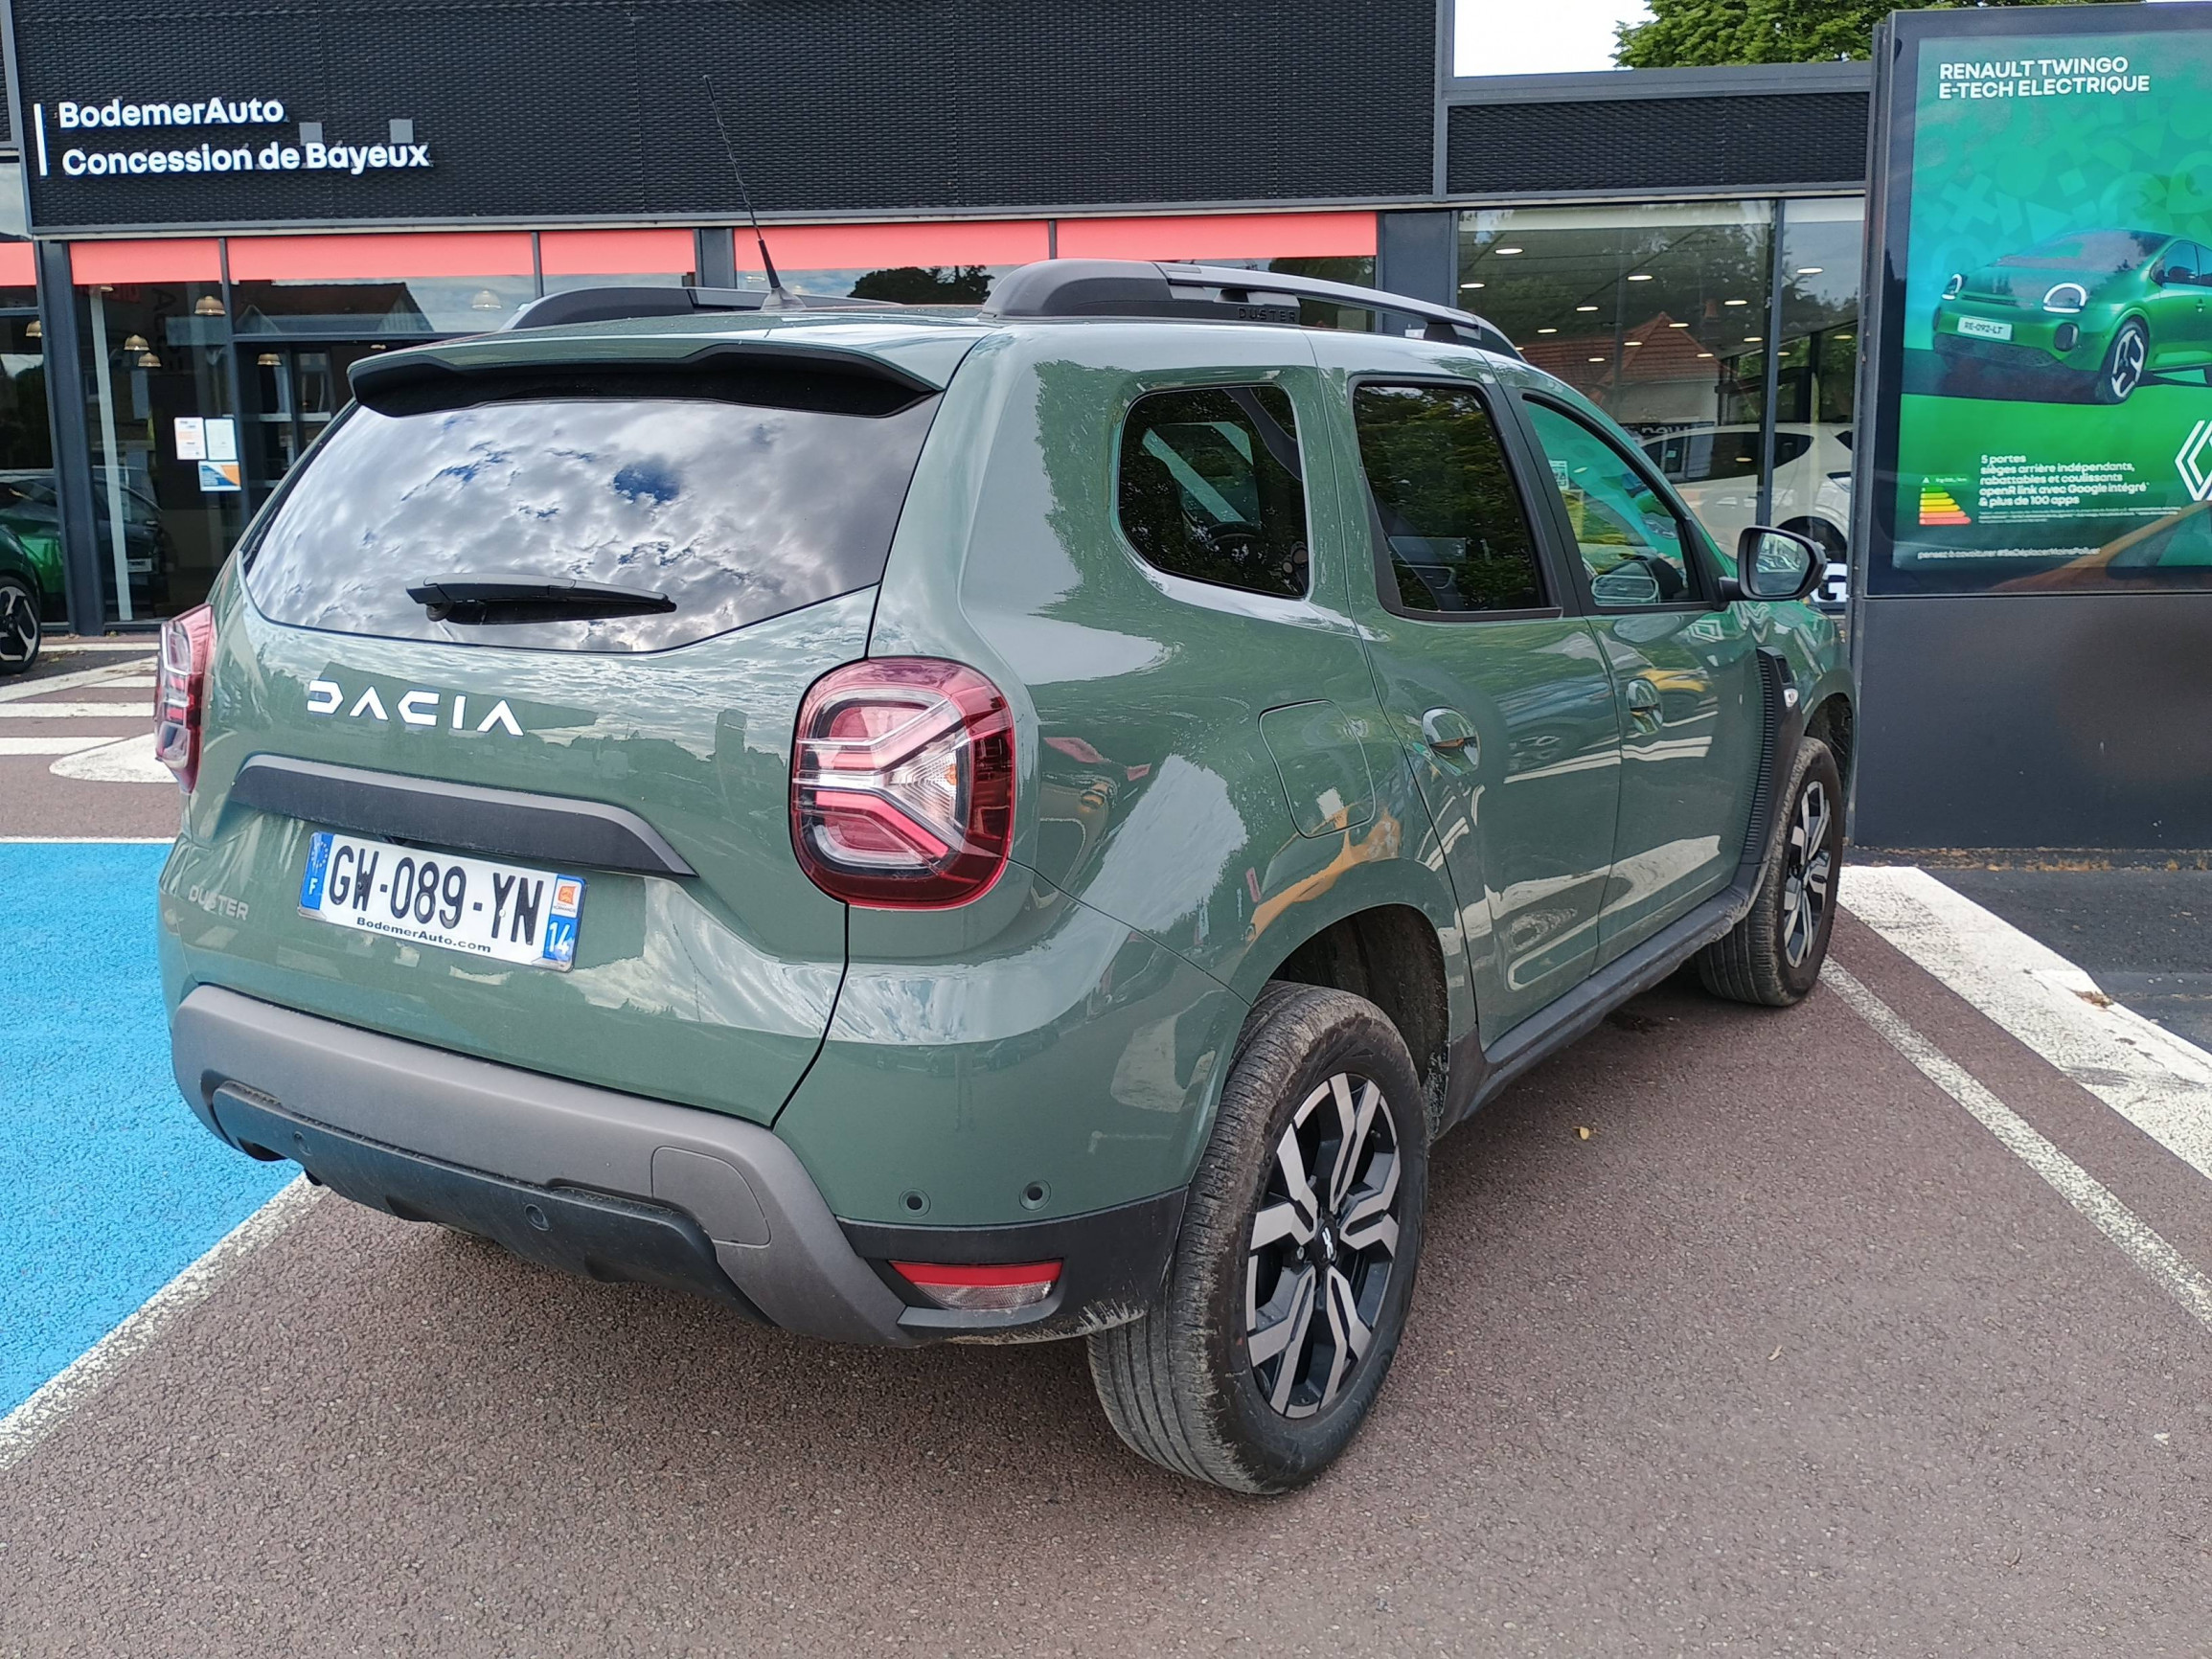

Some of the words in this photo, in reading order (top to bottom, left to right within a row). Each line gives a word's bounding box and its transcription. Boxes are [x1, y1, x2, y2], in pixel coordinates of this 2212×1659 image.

[1939, 60, 2036, 80] RENAULT
[2038, 57, 2129, 76] TWINGO
[1938, 80, 2013, 100] E-TECH
[2018, 75, 2151, 97] ELECTRIQUE
[57, 97, 285, 128] BodemerAuto
[61, 143, 254, 176] Concession
[258, 142, 300, 170] de
[306, 142, 431, 174] Bayeux
[1238, 307, 1296, 322] DUSTER
[1989, 454, 2027, 466] portes
[2038, 485, 2067, 495] avec
[2067, 483, 2108, 495] Google
[2047, 473, 2061, 484] et
[1989, 496, 2013, 509] plus
[2014, 495, 2029, 506] de
[2030, 495, 2050, 505] 100
[2050, 495, 2081, 507] apps
[307, 679, 525, 737] DACIA
[308, 877, 318, 896] F
[329, 845, 544, 945] GW-089-YN
[188, 884, 249, 920] DUSTER
[356, 916, 491, 953] BodemerAuto.com
[549, 921, 571, 955] 14
